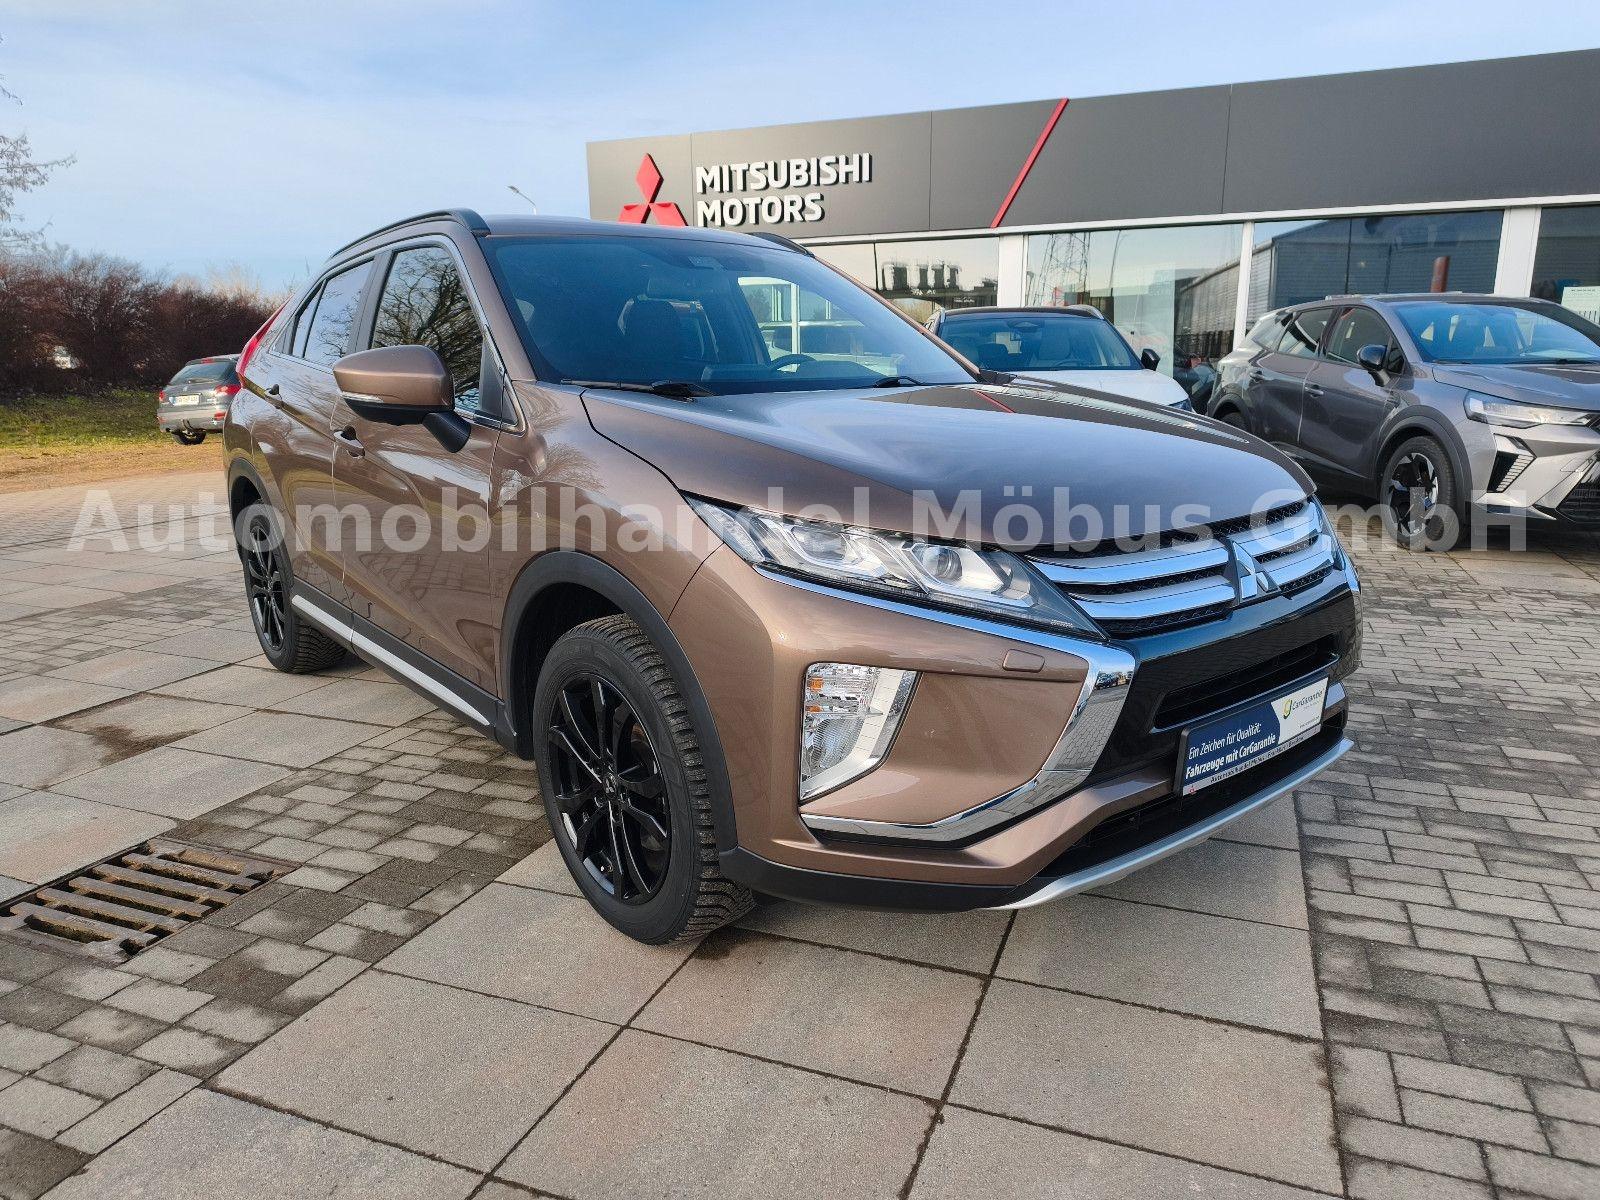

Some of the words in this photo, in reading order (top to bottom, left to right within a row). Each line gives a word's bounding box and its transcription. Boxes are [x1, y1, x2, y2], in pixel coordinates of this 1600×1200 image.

[695, 152, 872, 194] MITSUBISHI
[696, 192, 825, 228] MOTORS
[1185, 756, 1225, 780] Fahrzeuge
[1225, 749, 1239, 764] mit
[1239, 733, 1276, 758] CarGarantie
[1188, 746, 1200, 760] Ein
[1200, 739, 1226, 756] Zeichen
[1226, 732, 1236, 746] für
[1236, 722, 1262, 742] Qualität:
